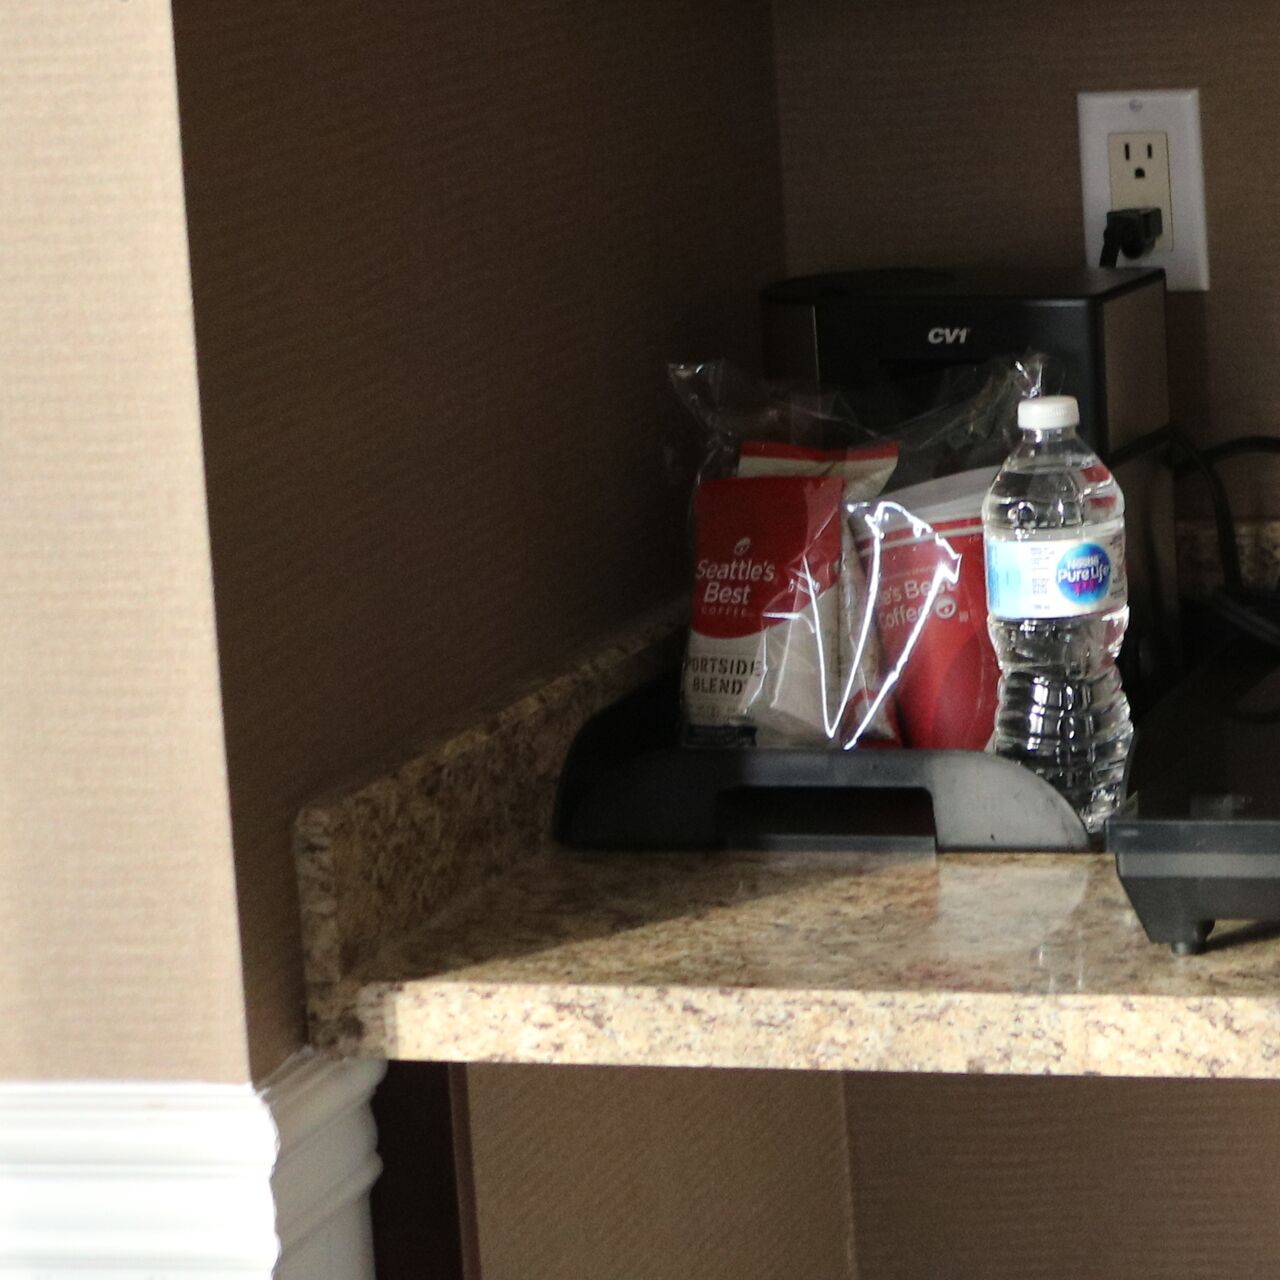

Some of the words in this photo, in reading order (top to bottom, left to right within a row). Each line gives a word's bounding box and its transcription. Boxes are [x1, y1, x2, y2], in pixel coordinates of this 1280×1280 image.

[695, 559, 775, 582] Seattle's
[1057, 567, 1090, 584] Pure
[1090, 563, 1110, 584] Life
[703, 582, 752, 605] Best
[684, 656, 764, 677] PORTSIDE
[691, 677, 744, 696] BLEND
